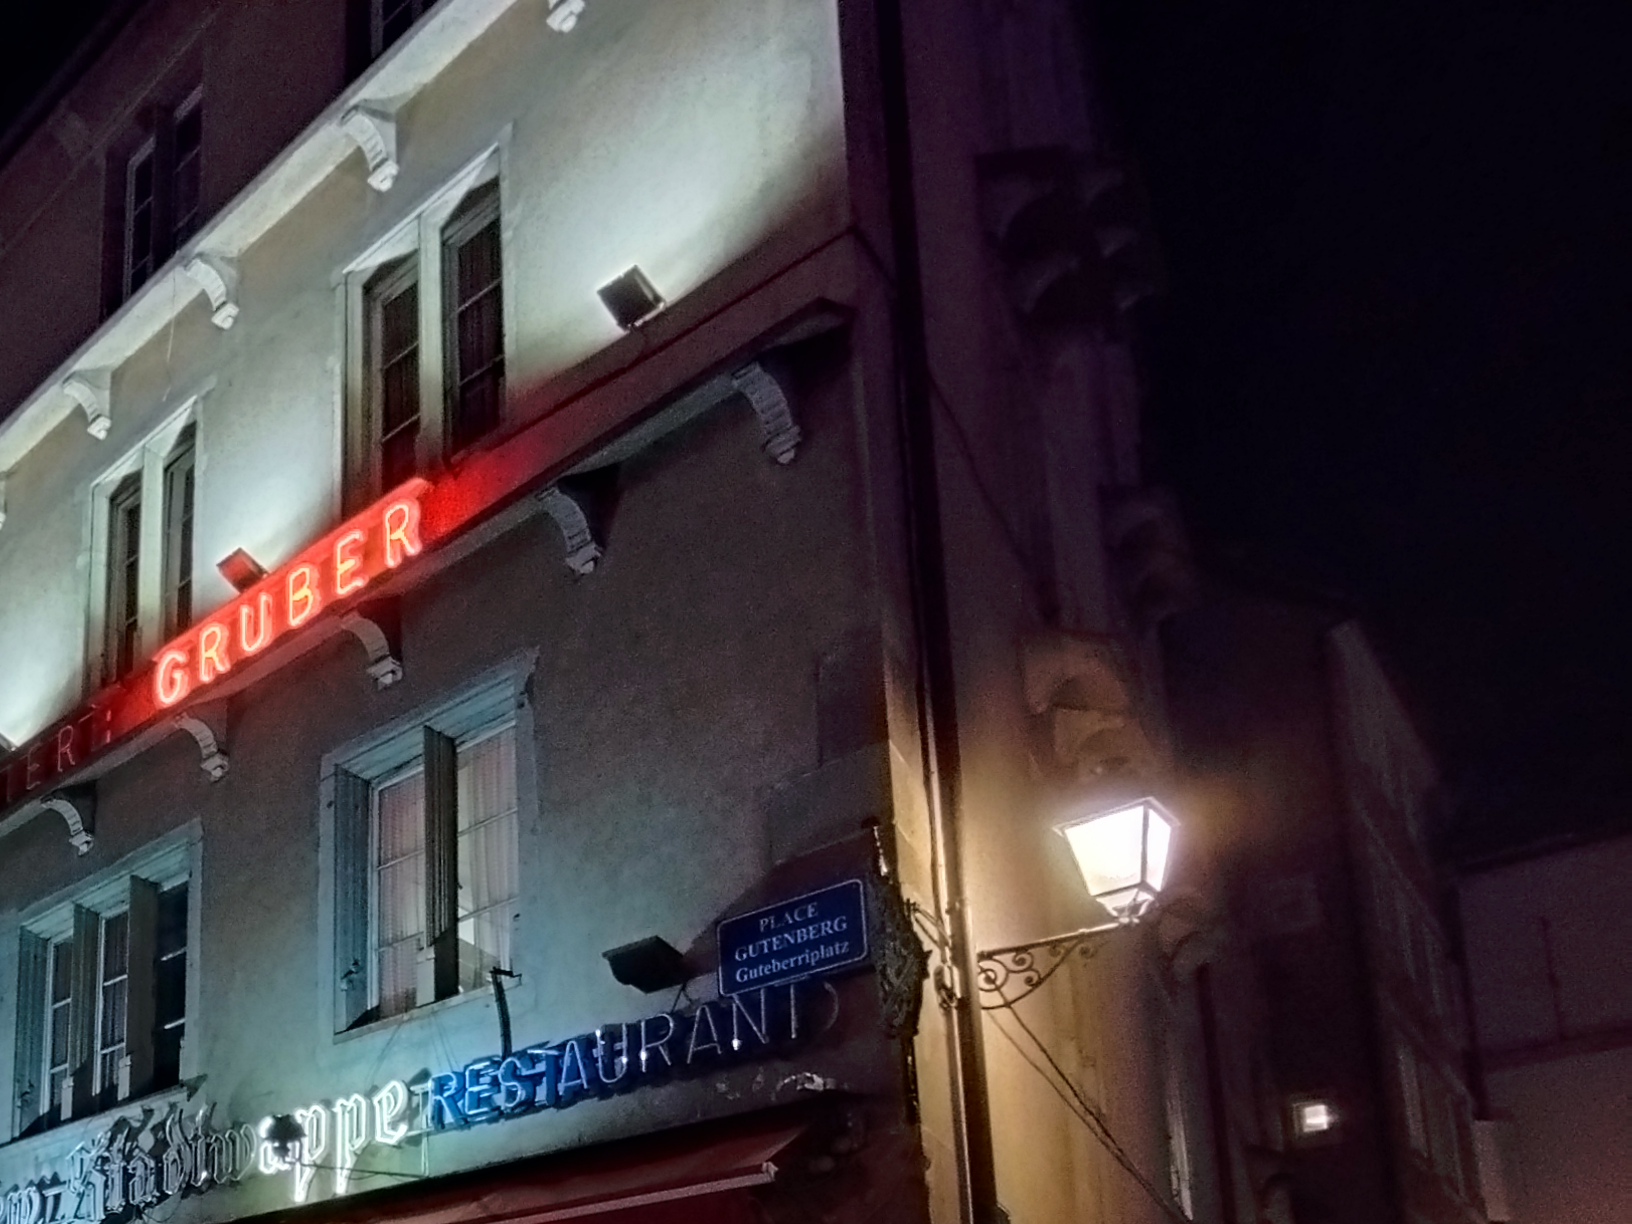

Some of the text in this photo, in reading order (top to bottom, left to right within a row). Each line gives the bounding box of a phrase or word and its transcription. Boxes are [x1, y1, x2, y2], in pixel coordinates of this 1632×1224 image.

[153, 498, 423, 706] GRUBER
[735, 915, 848, 962] GUTENBERG
[759, 902, 818, 933] PLACE
[427, 974, 811, 1131] RESTAURANT
